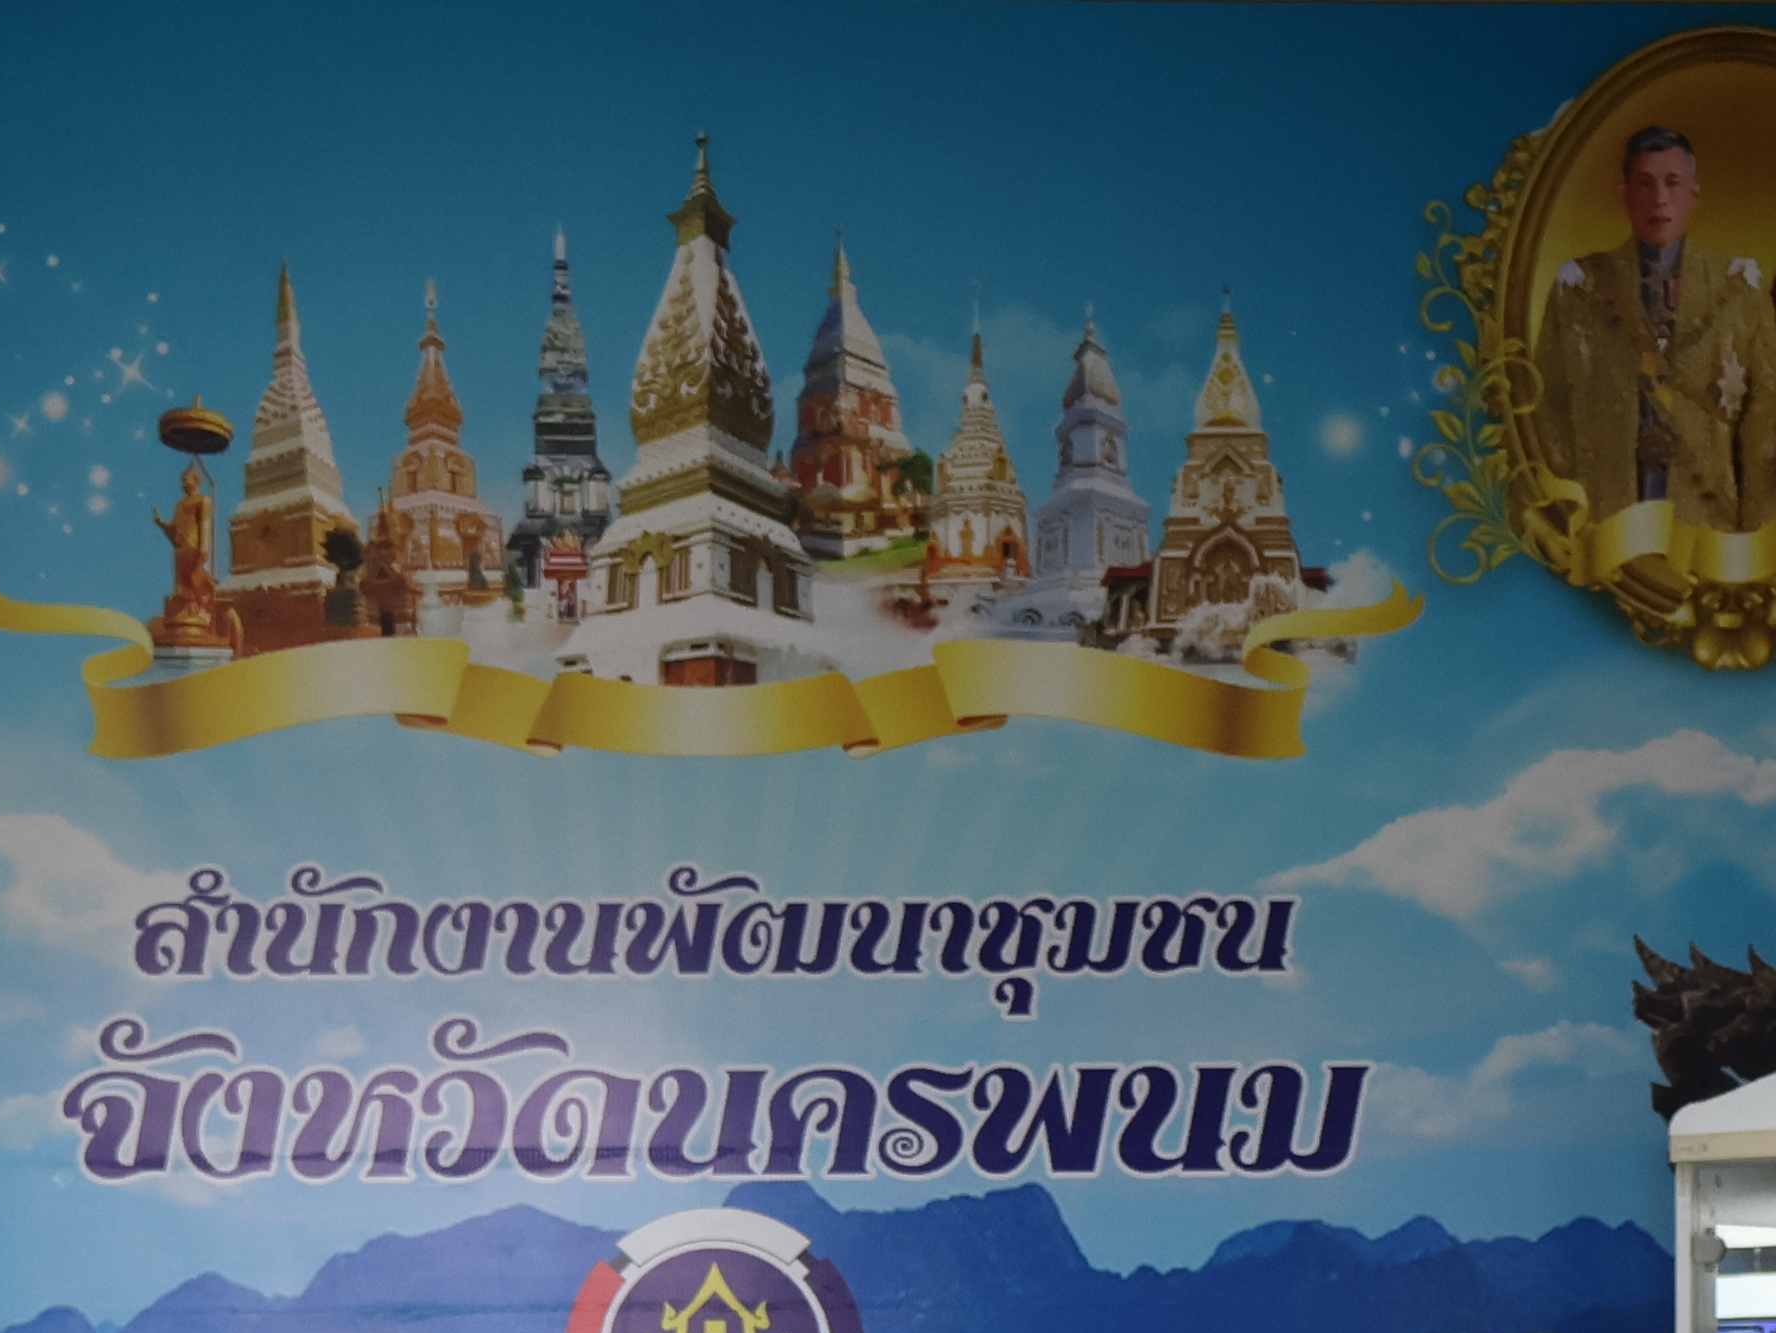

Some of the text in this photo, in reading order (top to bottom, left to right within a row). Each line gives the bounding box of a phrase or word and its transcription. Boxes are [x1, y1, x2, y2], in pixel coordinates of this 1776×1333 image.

[132, 862, 1299, 1020] สำนักงานพัฒนาชุมชน
[62, 1014, 1371, 1184] จังหวัดนครพนม
